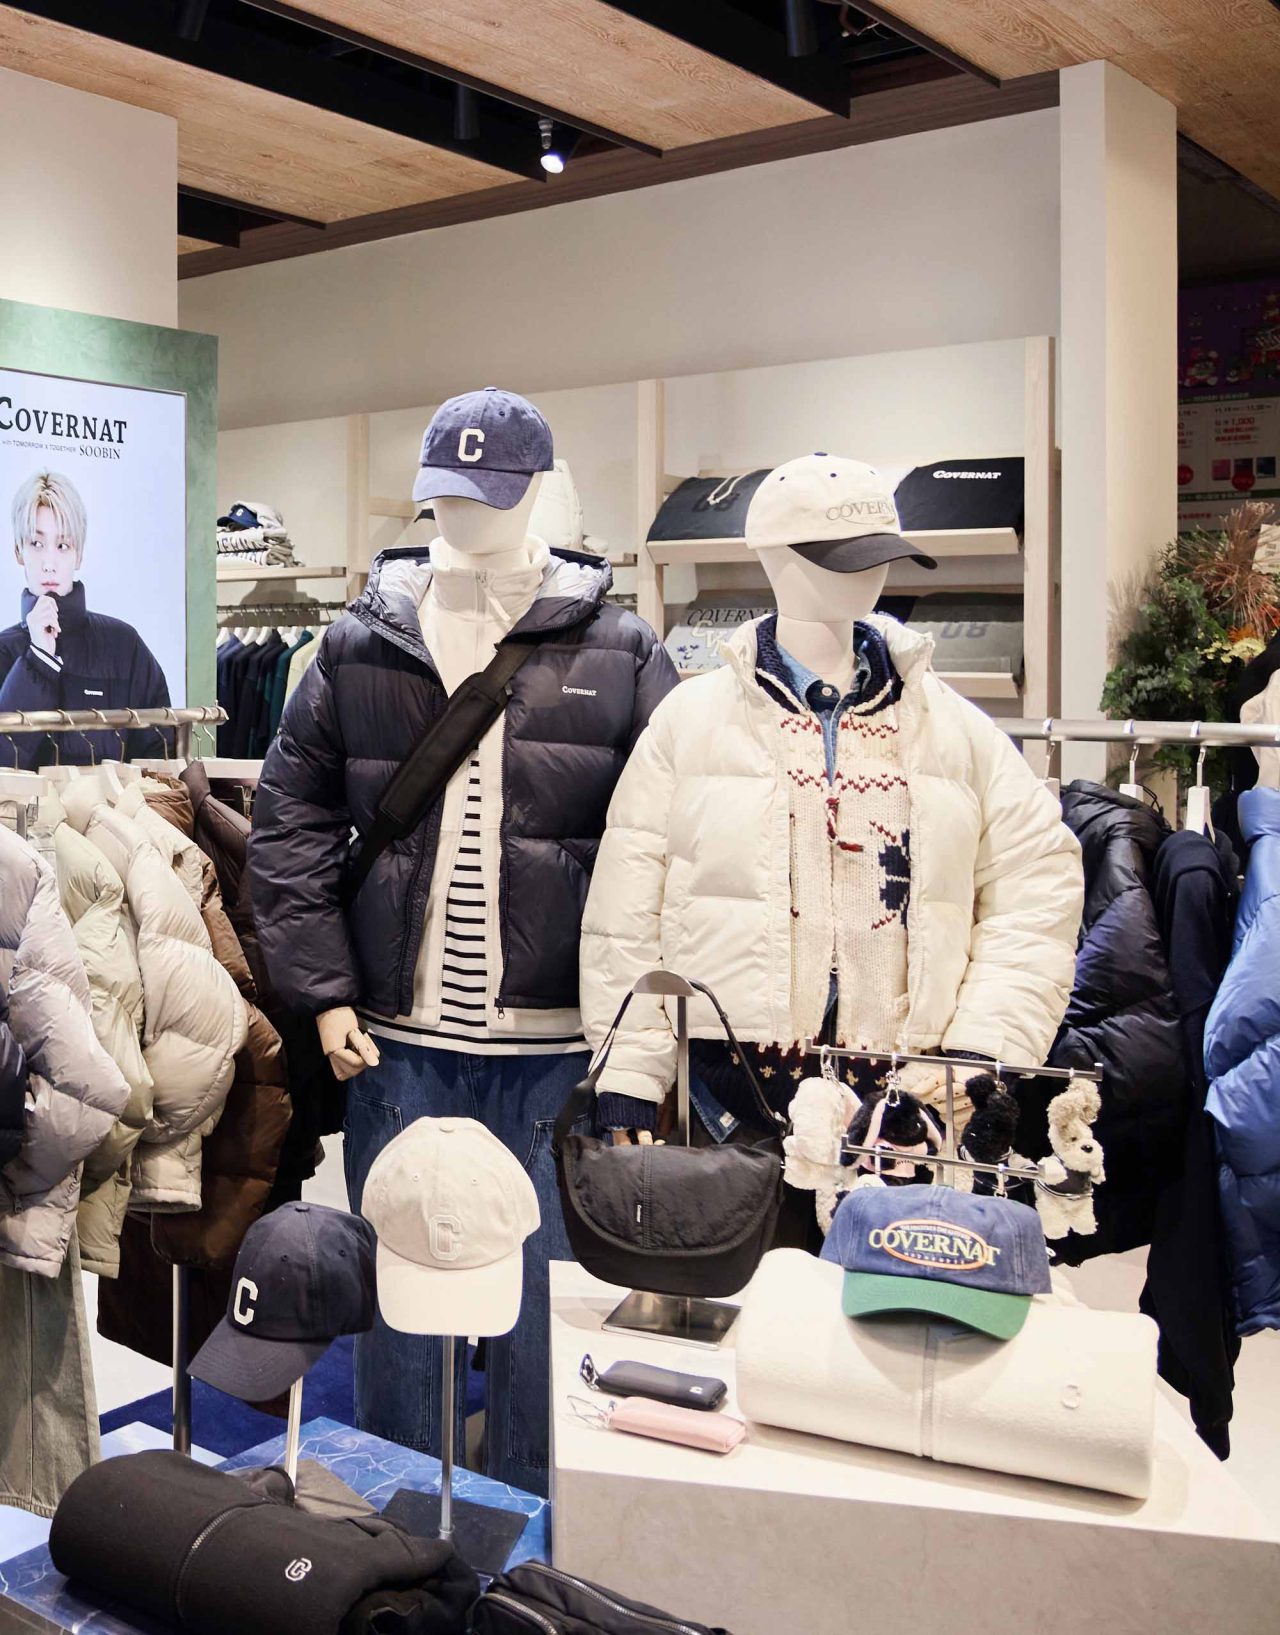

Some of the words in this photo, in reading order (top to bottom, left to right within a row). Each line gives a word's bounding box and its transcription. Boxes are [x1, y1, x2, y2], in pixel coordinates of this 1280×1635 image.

[79, 445, 121, 460] SOOBIN
[457, 428, 485, 462] C
[933, 470, 1001, 480] COVERNAT
[429, 1214, 463, 1261] C
[869, 1228, 1001, 1266] COVERNAT
[233, 1276, 258, 1326] C
